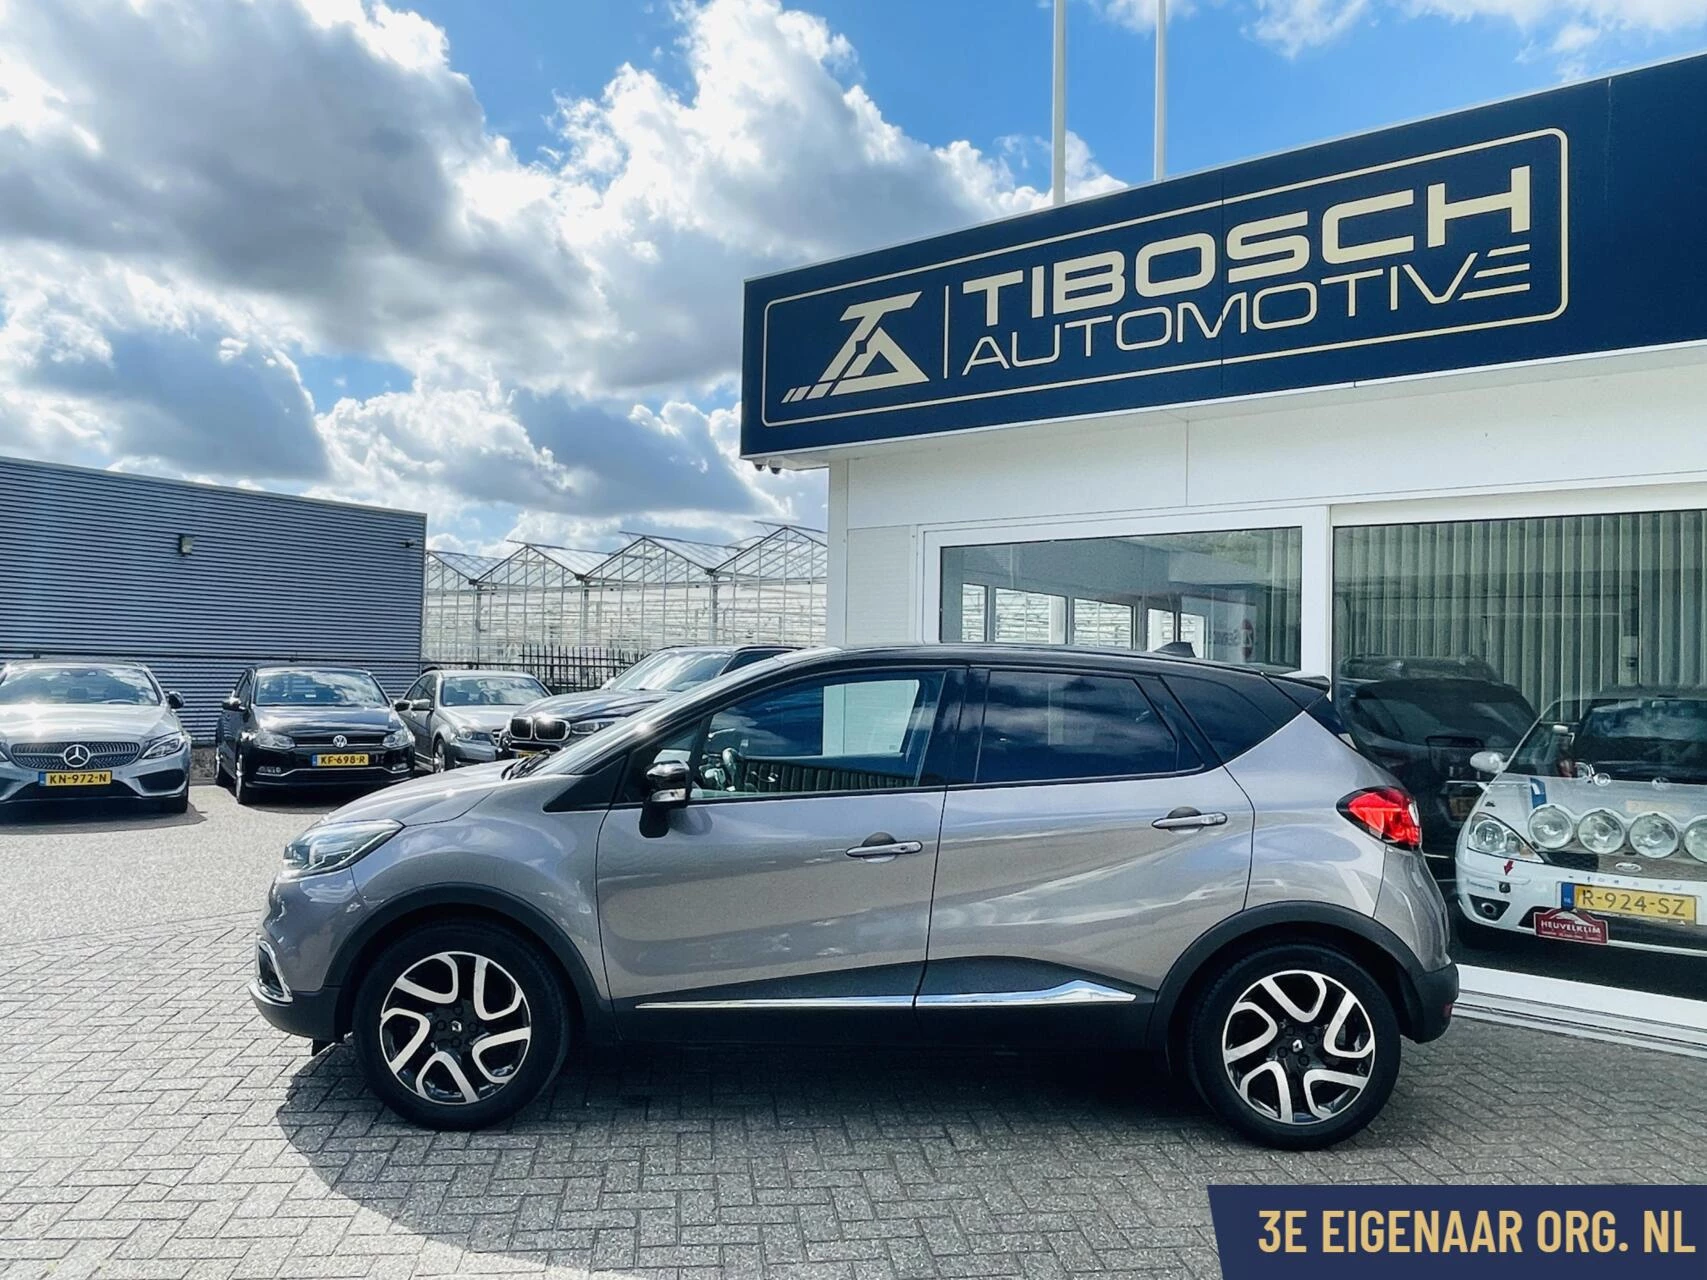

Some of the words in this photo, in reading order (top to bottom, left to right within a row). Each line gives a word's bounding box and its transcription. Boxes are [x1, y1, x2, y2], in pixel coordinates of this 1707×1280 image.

[963, 166, 1530, 327] TIBOSCH
[961, 244, 1530, 376] AUTOMOTIVE
[320, 756, 365, 765] KF-698-R
[49, 773, 107, 784] KN-972-N
[1582, 889, 1686, 917] R-924-SZ
[1540, 920, 1601, 934] HEUVELKLIM
